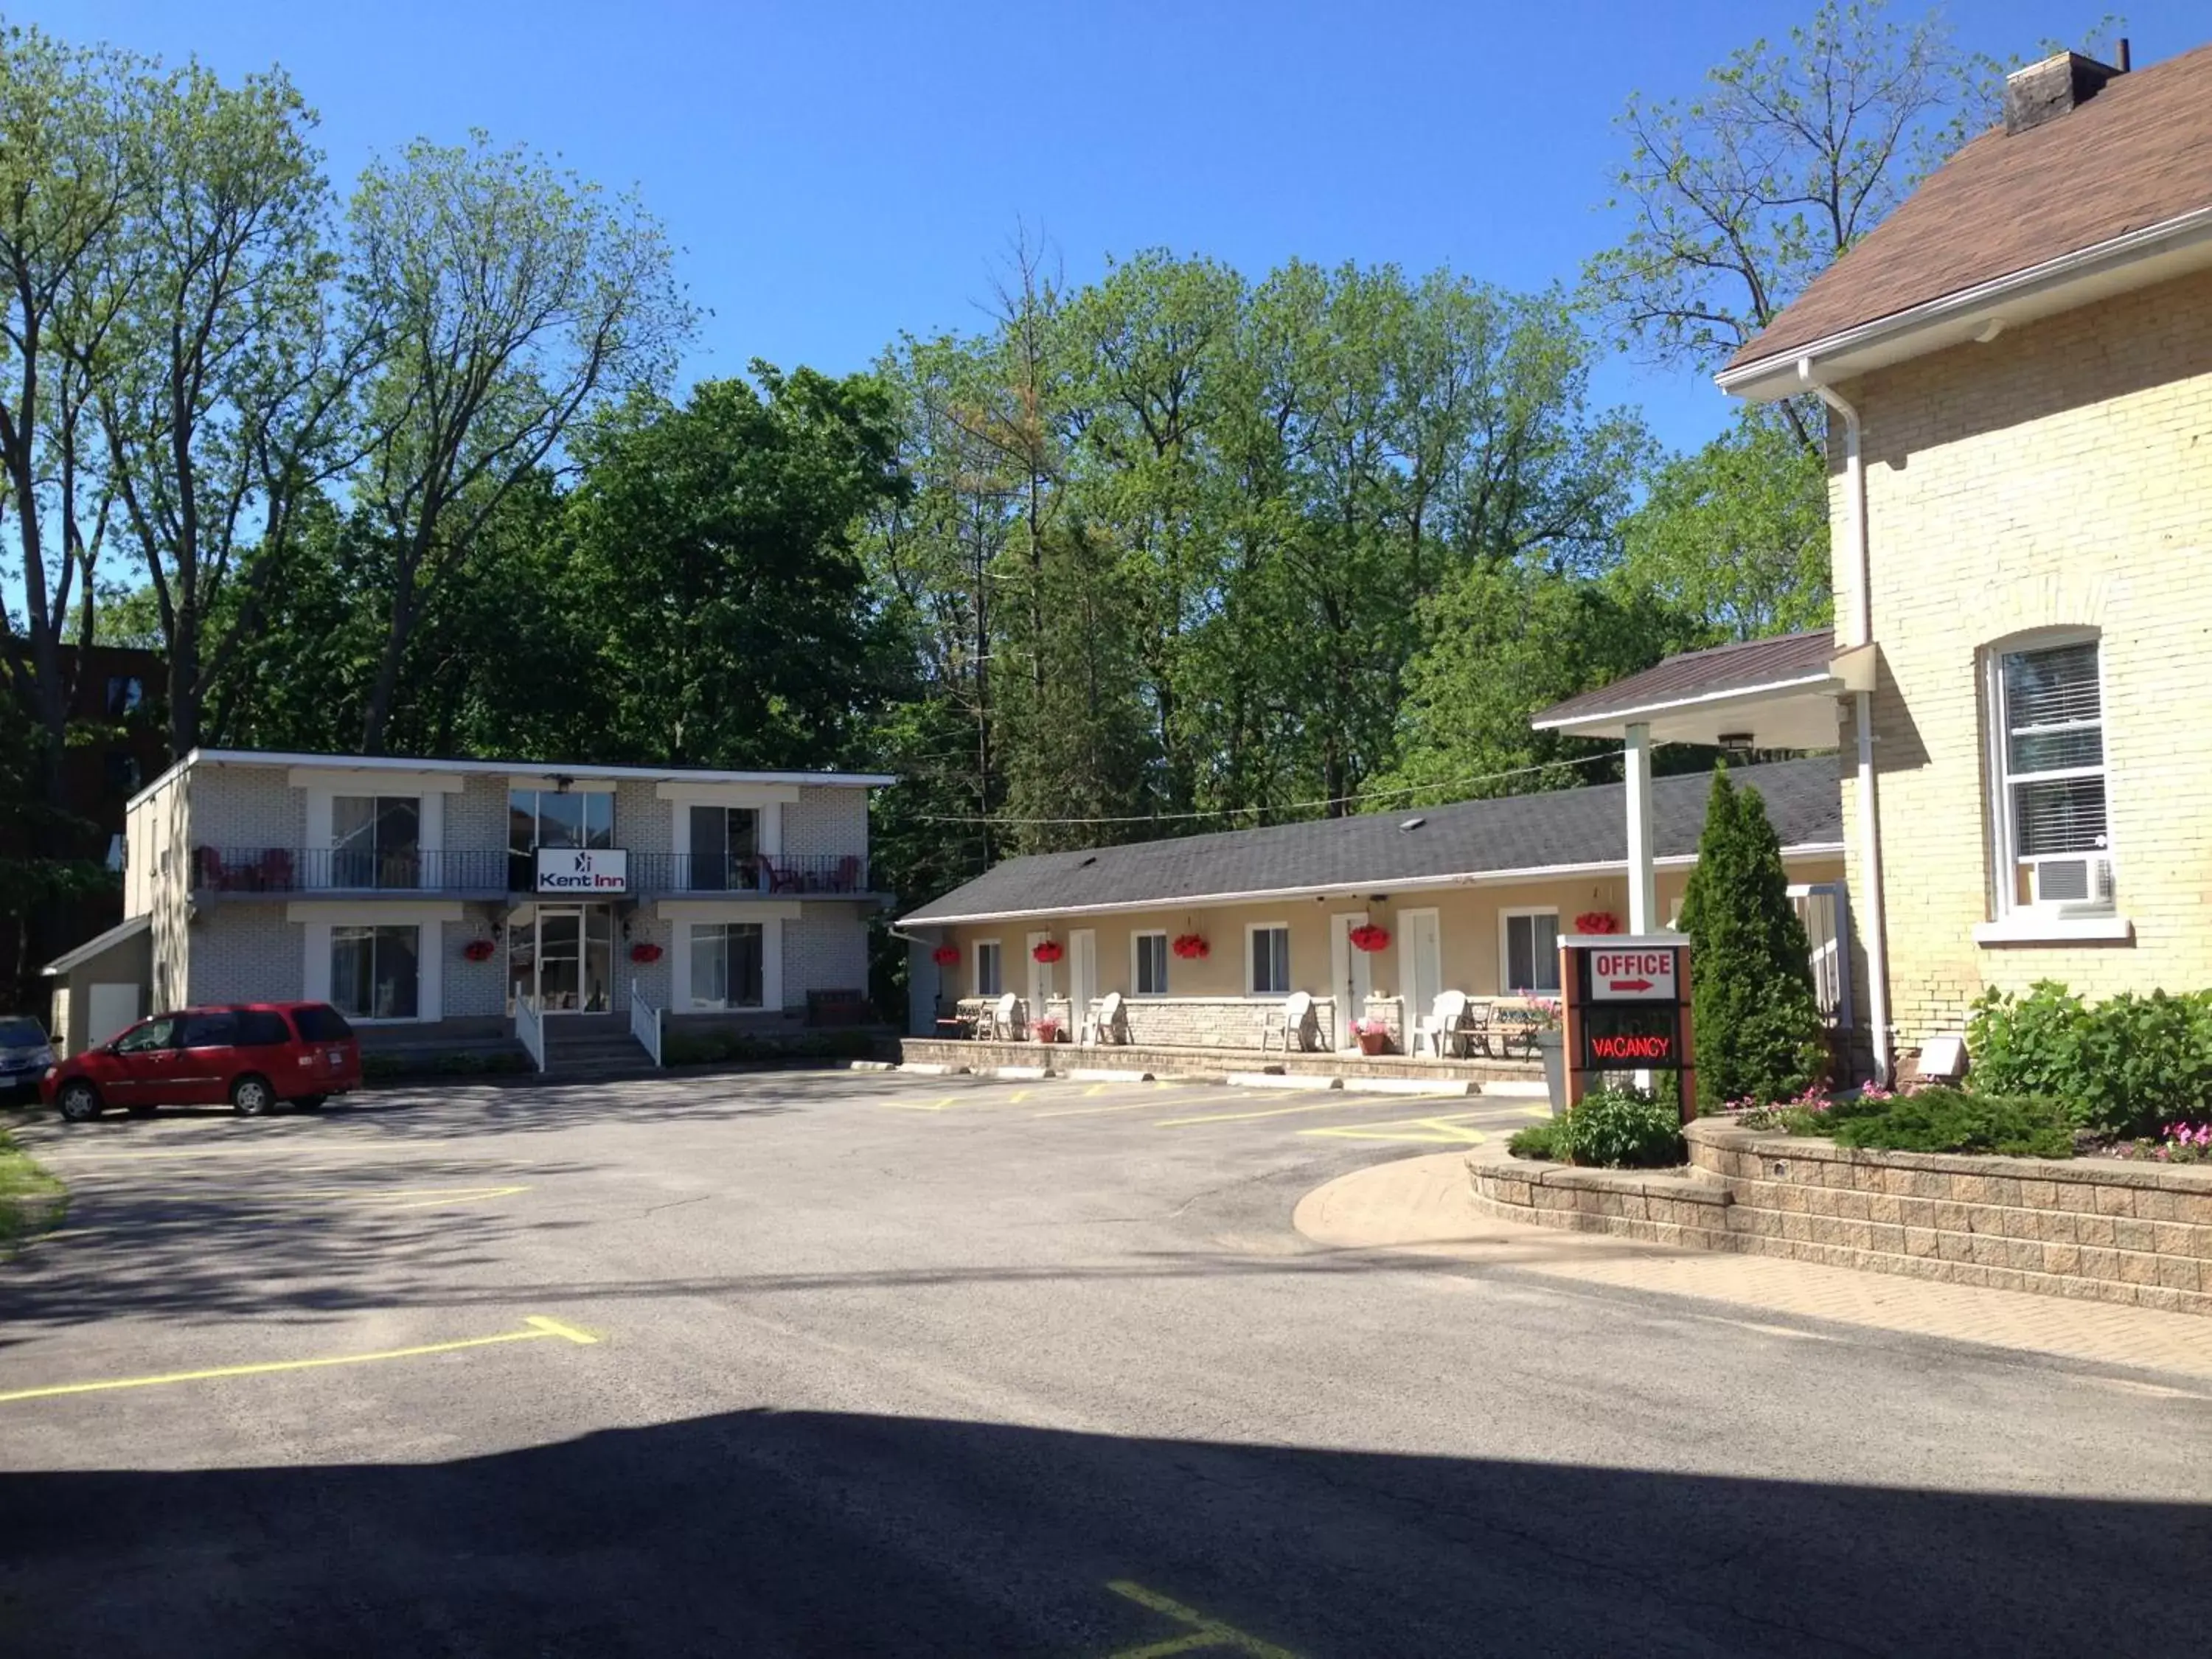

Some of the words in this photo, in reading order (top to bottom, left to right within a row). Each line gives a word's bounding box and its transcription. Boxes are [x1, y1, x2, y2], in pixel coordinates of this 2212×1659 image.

[540, 873, 591, 886] Kent
[595, 874, 624, 887] Inn
[1597, 954, 1671, 976] OFFICE
[1592, 1037, 1669, 1058] VACANCY
